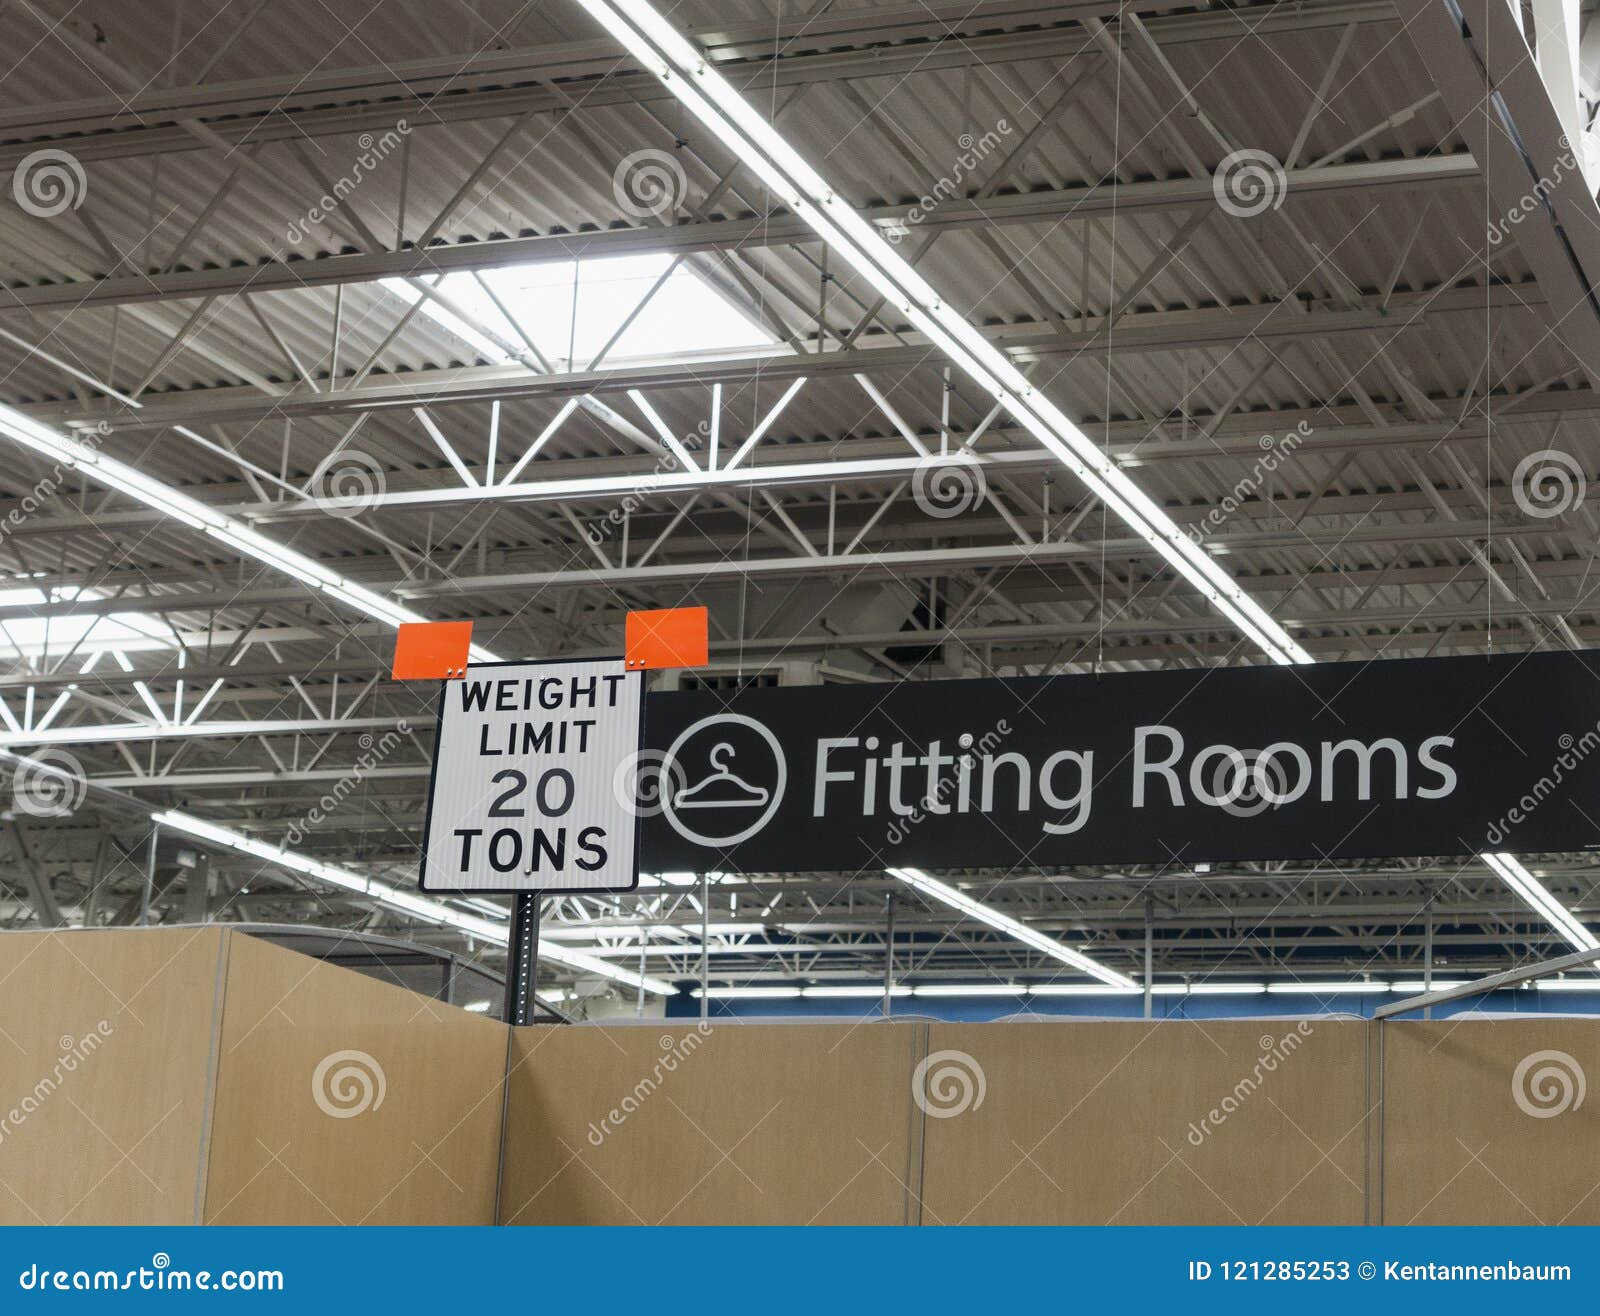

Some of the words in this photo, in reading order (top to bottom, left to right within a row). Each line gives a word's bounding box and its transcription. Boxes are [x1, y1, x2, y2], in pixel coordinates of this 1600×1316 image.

[461, 675, 625, 713] WEIGHT
[480, 720, 596, 756] LIMIT
[488, 768, 575, 818] 20
[812, 735, 1094, 835] Fitting
[1132, 726, 1457, 808] Rooms
[453, 826, 608, 873] TONS
